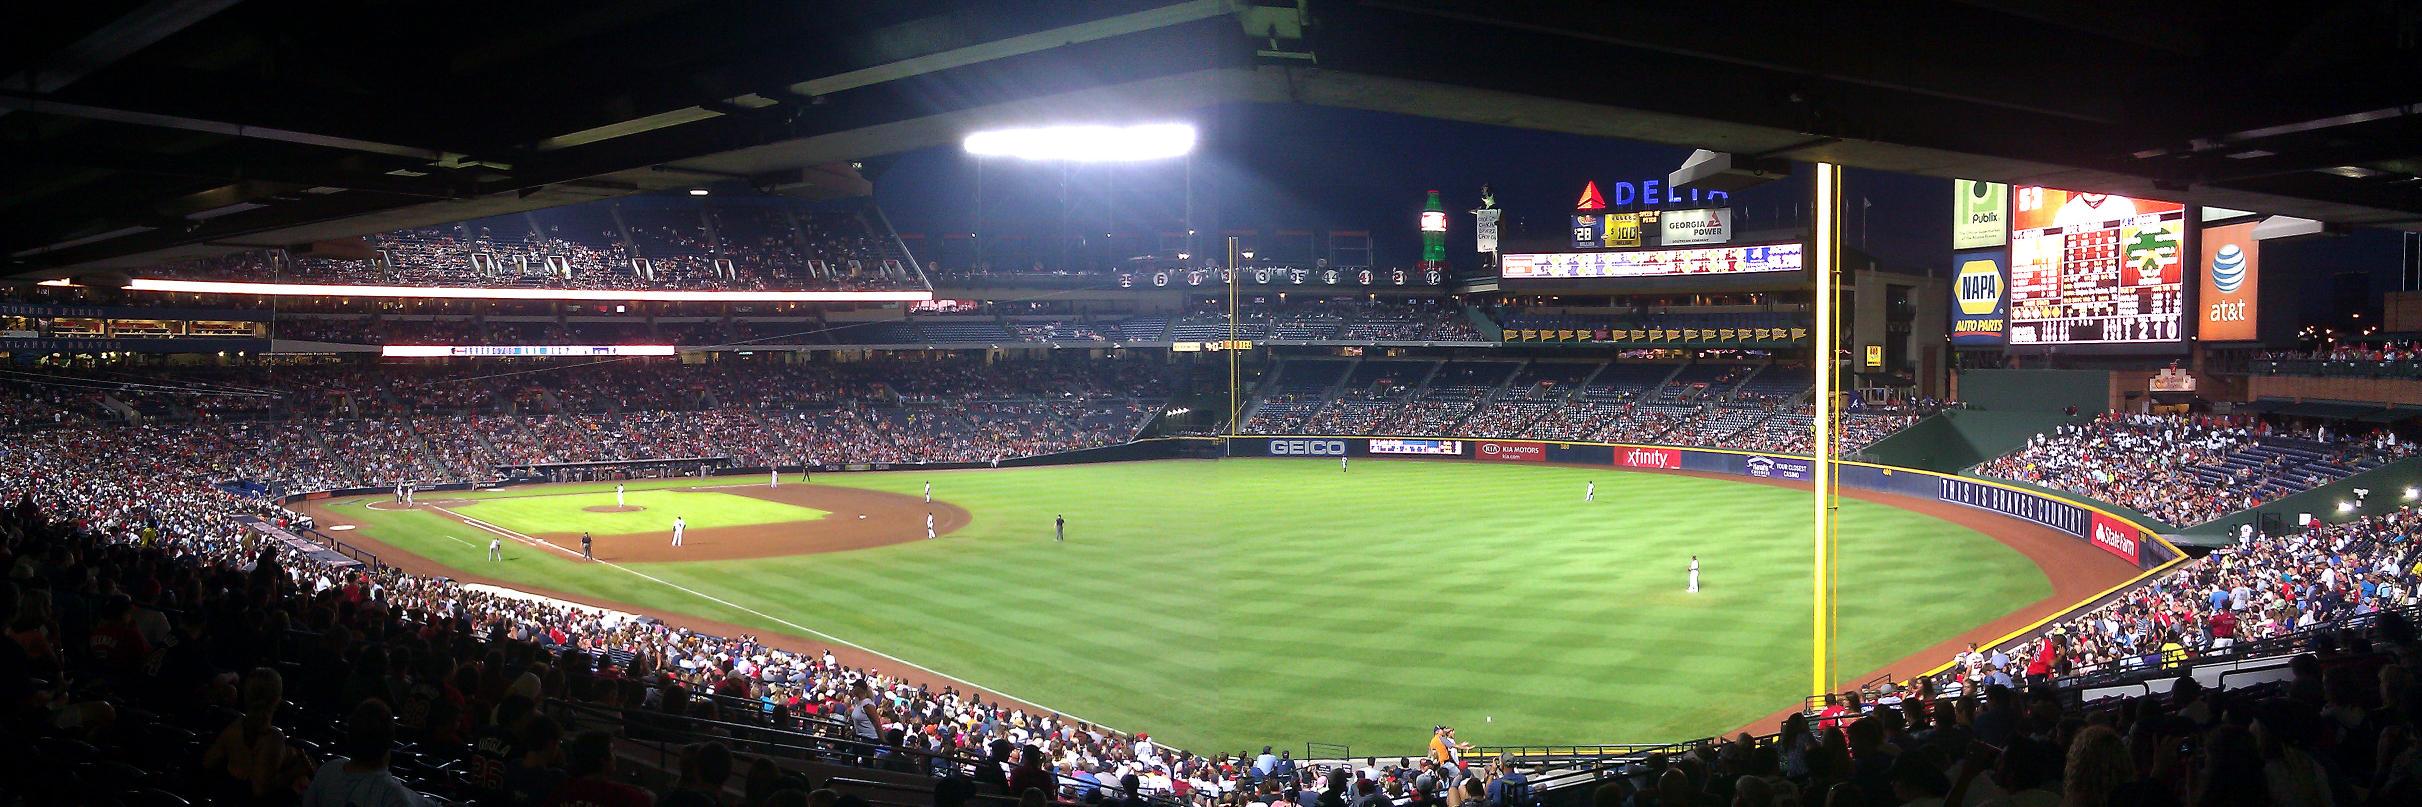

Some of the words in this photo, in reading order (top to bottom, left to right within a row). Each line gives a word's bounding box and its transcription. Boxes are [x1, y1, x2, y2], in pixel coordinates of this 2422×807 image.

[1669, 221, 1705, 229] GEORGIA
[1694, 228, 1722, 236] POWER
[1962, 275, 1996, 300] NAPA
[2210, 298, 2246, 322] at&t
[1955, 319, 1977, 332] AUTO
[1978, 319, 2004, 332] PARTS
[1270, 440, 1346, 455] GEICO
[1514, 446, 1539, 454] MOTORS
[1627, 448, 1669, 468] xfinity
[1788, 465, 1807, 473] CLOSEST
[1942, 479, 1970, 503] THIS
[1975, 485, 1988, 507] IS
[1993, 488, 2033, 519] BRAVES
[2038, 498, 2082, 534] COUNTRY
[2105, 526, 2120, 549] State
[2120, 532, 2135, 557] Farm
